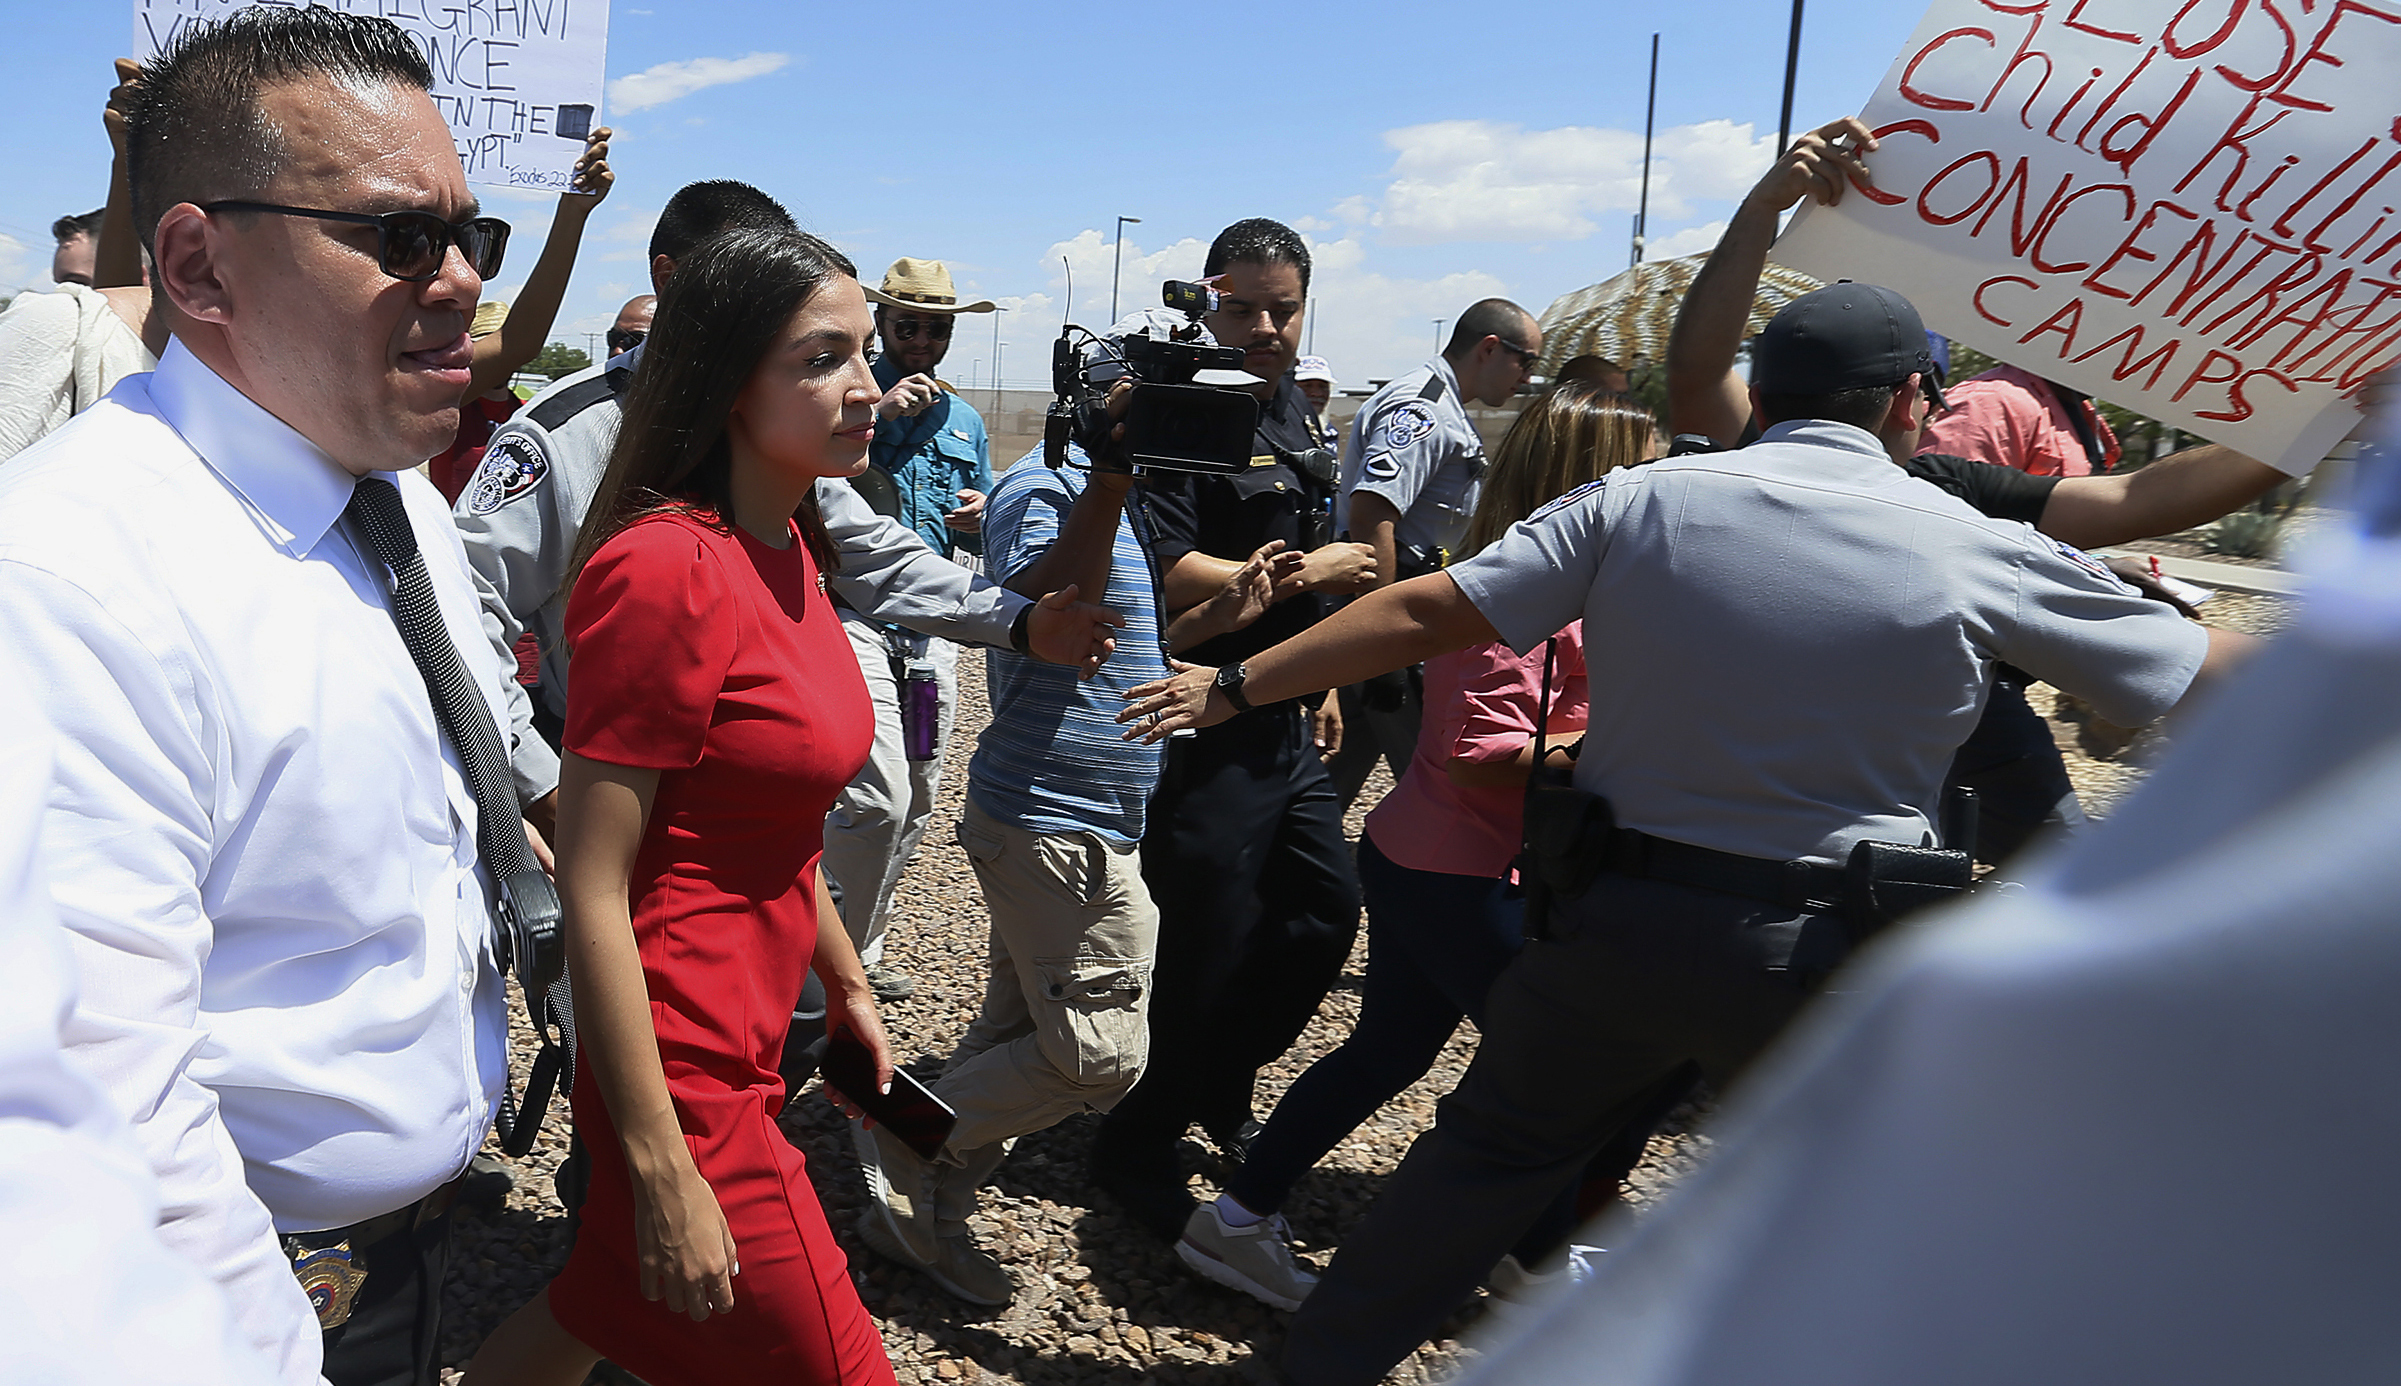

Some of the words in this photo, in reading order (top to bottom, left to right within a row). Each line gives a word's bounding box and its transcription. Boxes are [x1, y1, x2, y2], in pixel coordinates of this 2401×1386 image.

[481, 97, 554, 135] THE
[1898, 12, 2202, 178] Child
[1849, 118, 2401, 400] CONCENTRATIO
[1973, 275, 2300, 423] CAMPS
[520, 441, 544, 469] OFFICE
